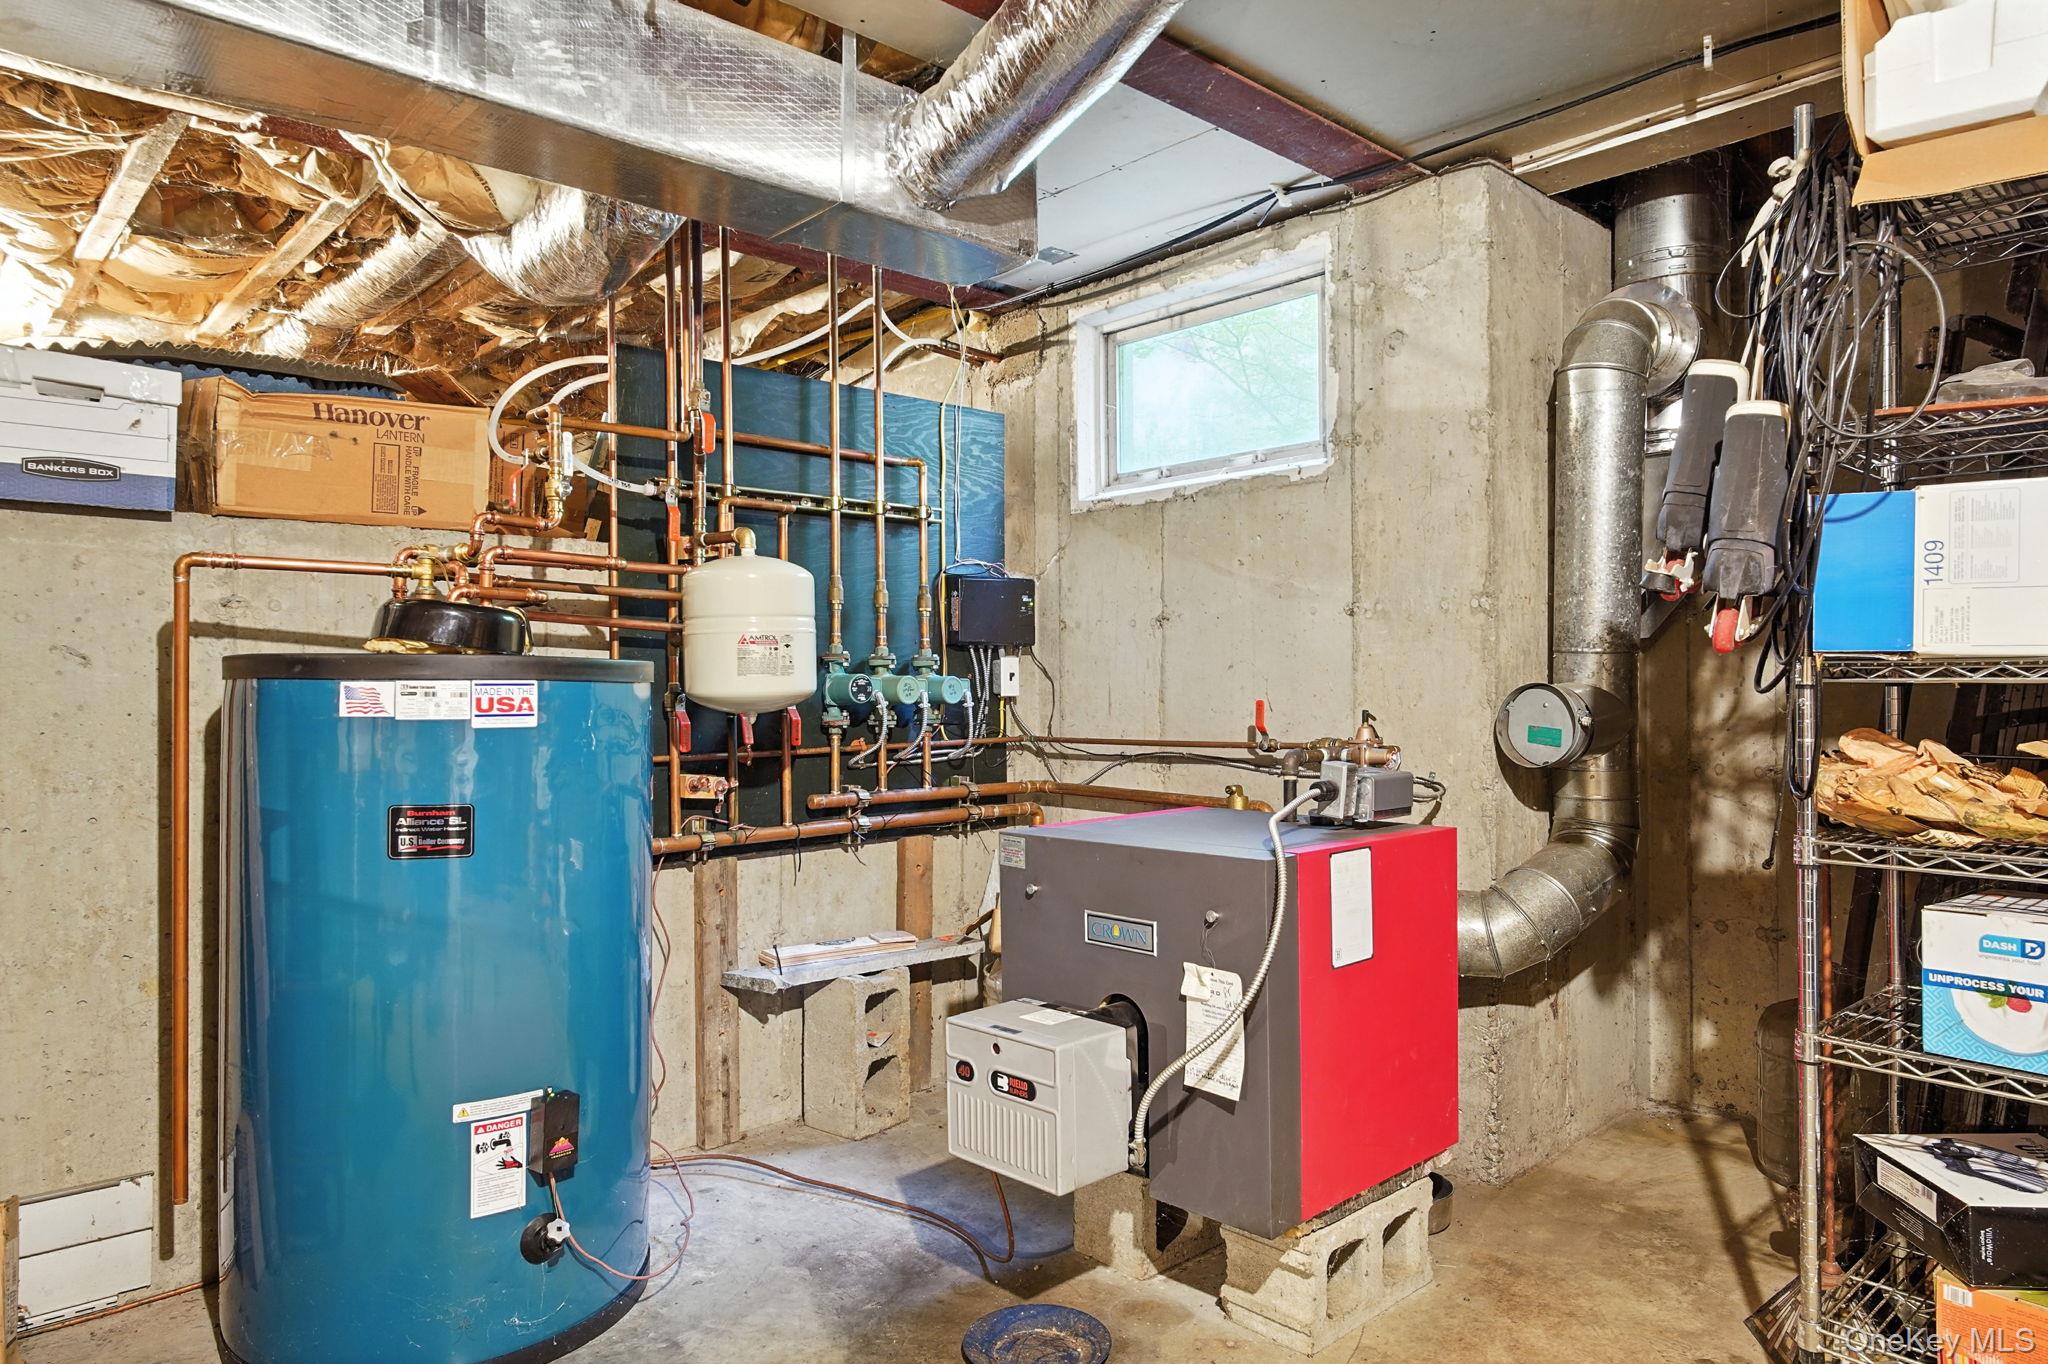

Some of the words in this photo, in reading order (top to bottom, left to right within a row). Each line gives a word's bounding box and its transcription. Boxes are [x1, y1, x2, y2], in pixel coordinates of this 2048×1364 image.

[312, 402, 425, 431] Hanover
[376, 428, 425, 443] LANTERN
[27, 462, 86, 474] BANKERS
[88, 467, 114, 476] BOX
[1924, 540, 1944, 585] 1409
[474, 687, 502, 696] MADE
[504, 687, 514, 695] IN
[516, 687, 534, 695] THE
[475, 696, 534, 713] USA
[396, 817, 445, 826] Alliance
[448, 816, 467, 825] SL
[1092, 922, 1147, 945] CROWN
[1982, 939, 2017, 952] DASH
[1928, 972, 2005, 992] UNPROCESS
[2008, 984, 2045, 999] YOUR
[958, 1064, 970, 1078] 40
[1009, 1077, 1028, 1091] RIELLO
[486, 1119, 521, 1132] DANGER
